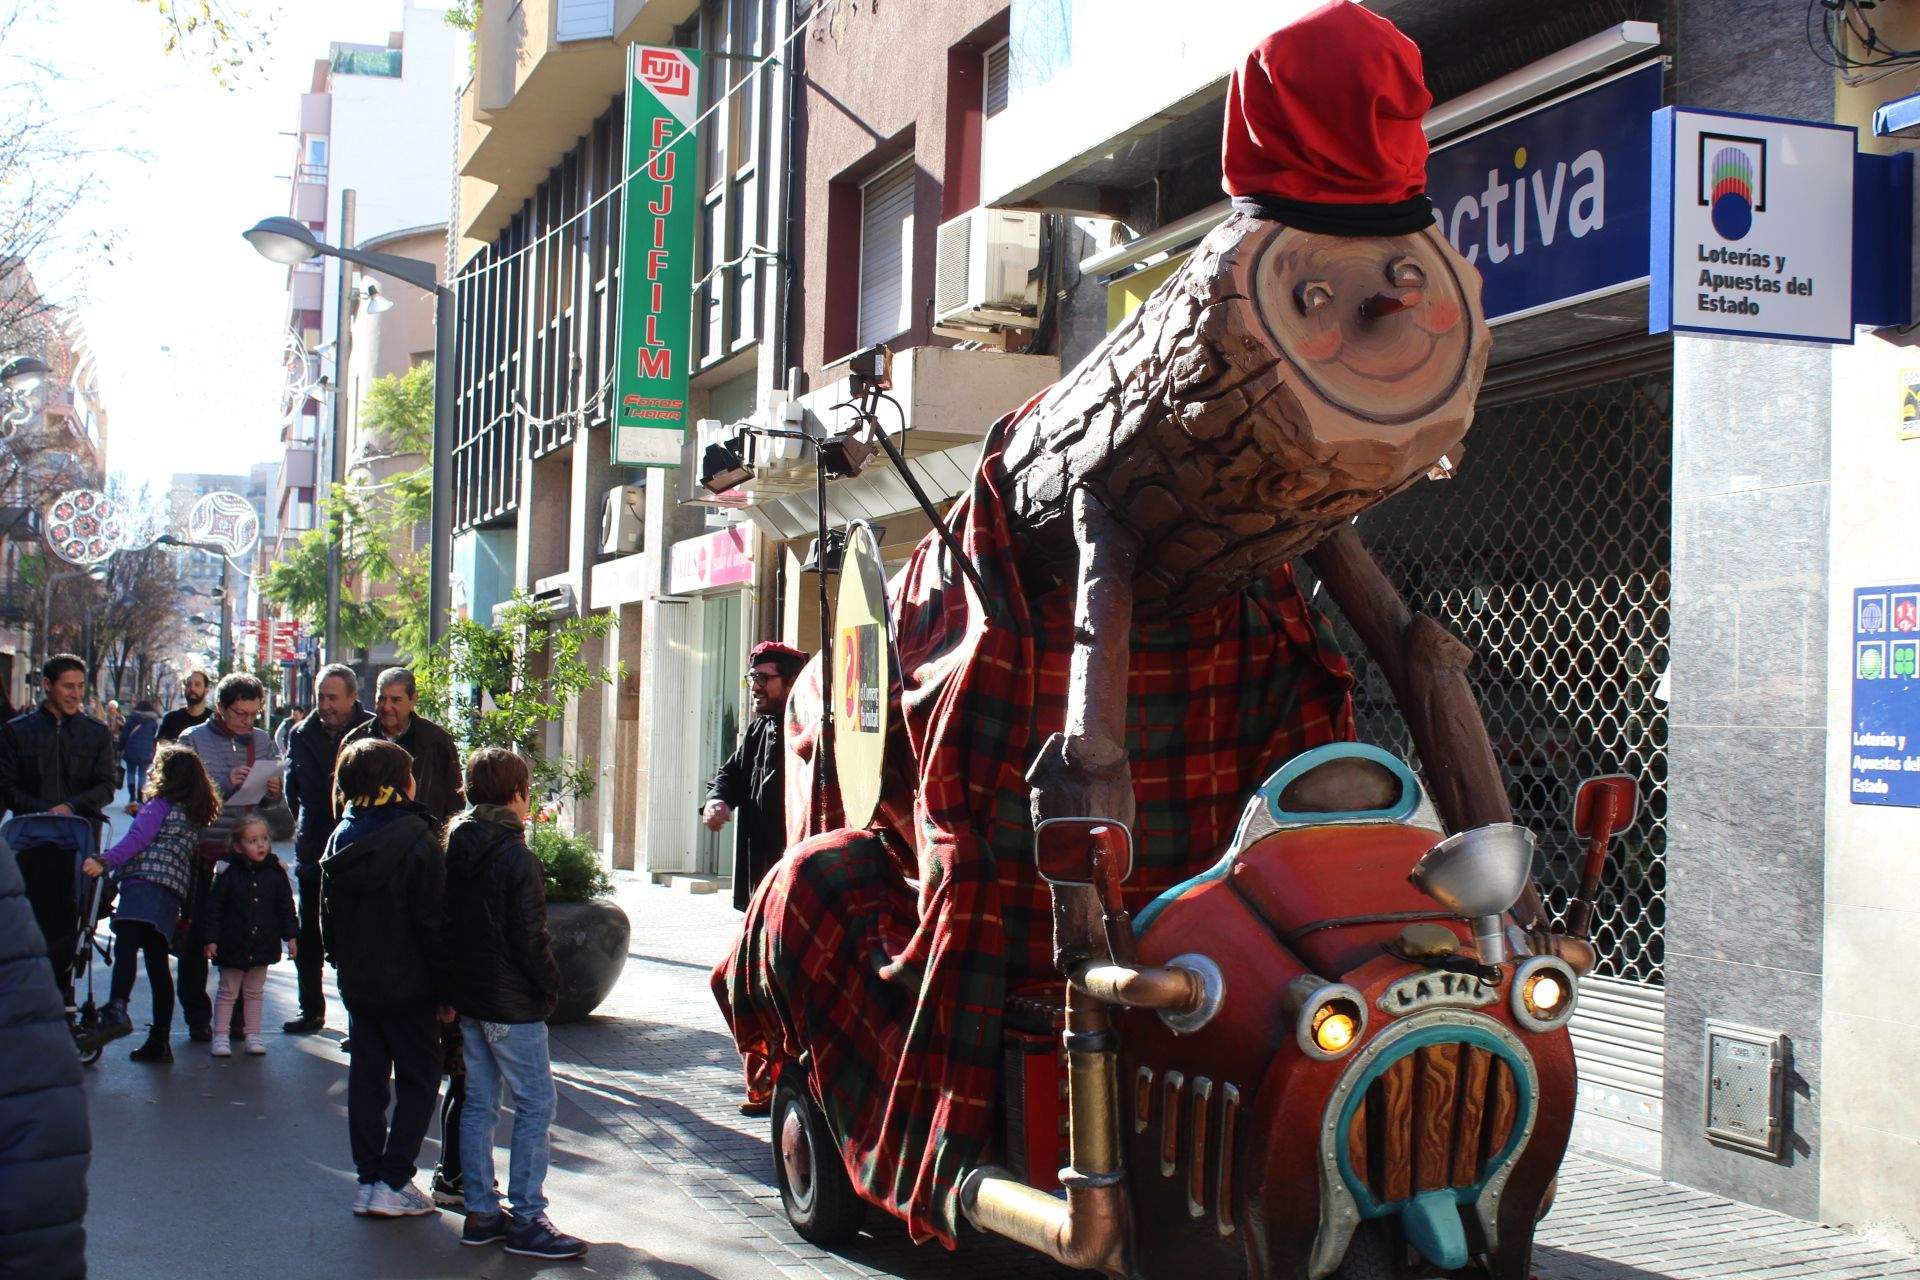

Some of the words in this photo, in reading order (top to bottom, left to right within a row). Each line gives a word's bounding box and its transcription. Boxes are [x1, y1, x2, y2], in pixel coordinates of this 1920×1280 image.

[641, 50, 691, 97] FUJI
[1432, 147, 1605, 265] ctiva
[637, 117, 676, 380] FUJIFILM
[1698, 244, 1770, 268] Loterías
[1775, 255, 1786, 274] y
[1698, 269, 1781, 293] Apuestas
[1786, 276, 1813, 296] del
[1698, 293, 1760, 316] Estado
[624, 394, 683, 408] FOTOS
[1853, 731, 1896, 747] Loterías
[1897, 735, 1906, 751] y
[1853, 754, 1902, 773] Apuestas
[1852, 778, 1889, 794] Estado
[1396, 979, 1432, 1006] LA
